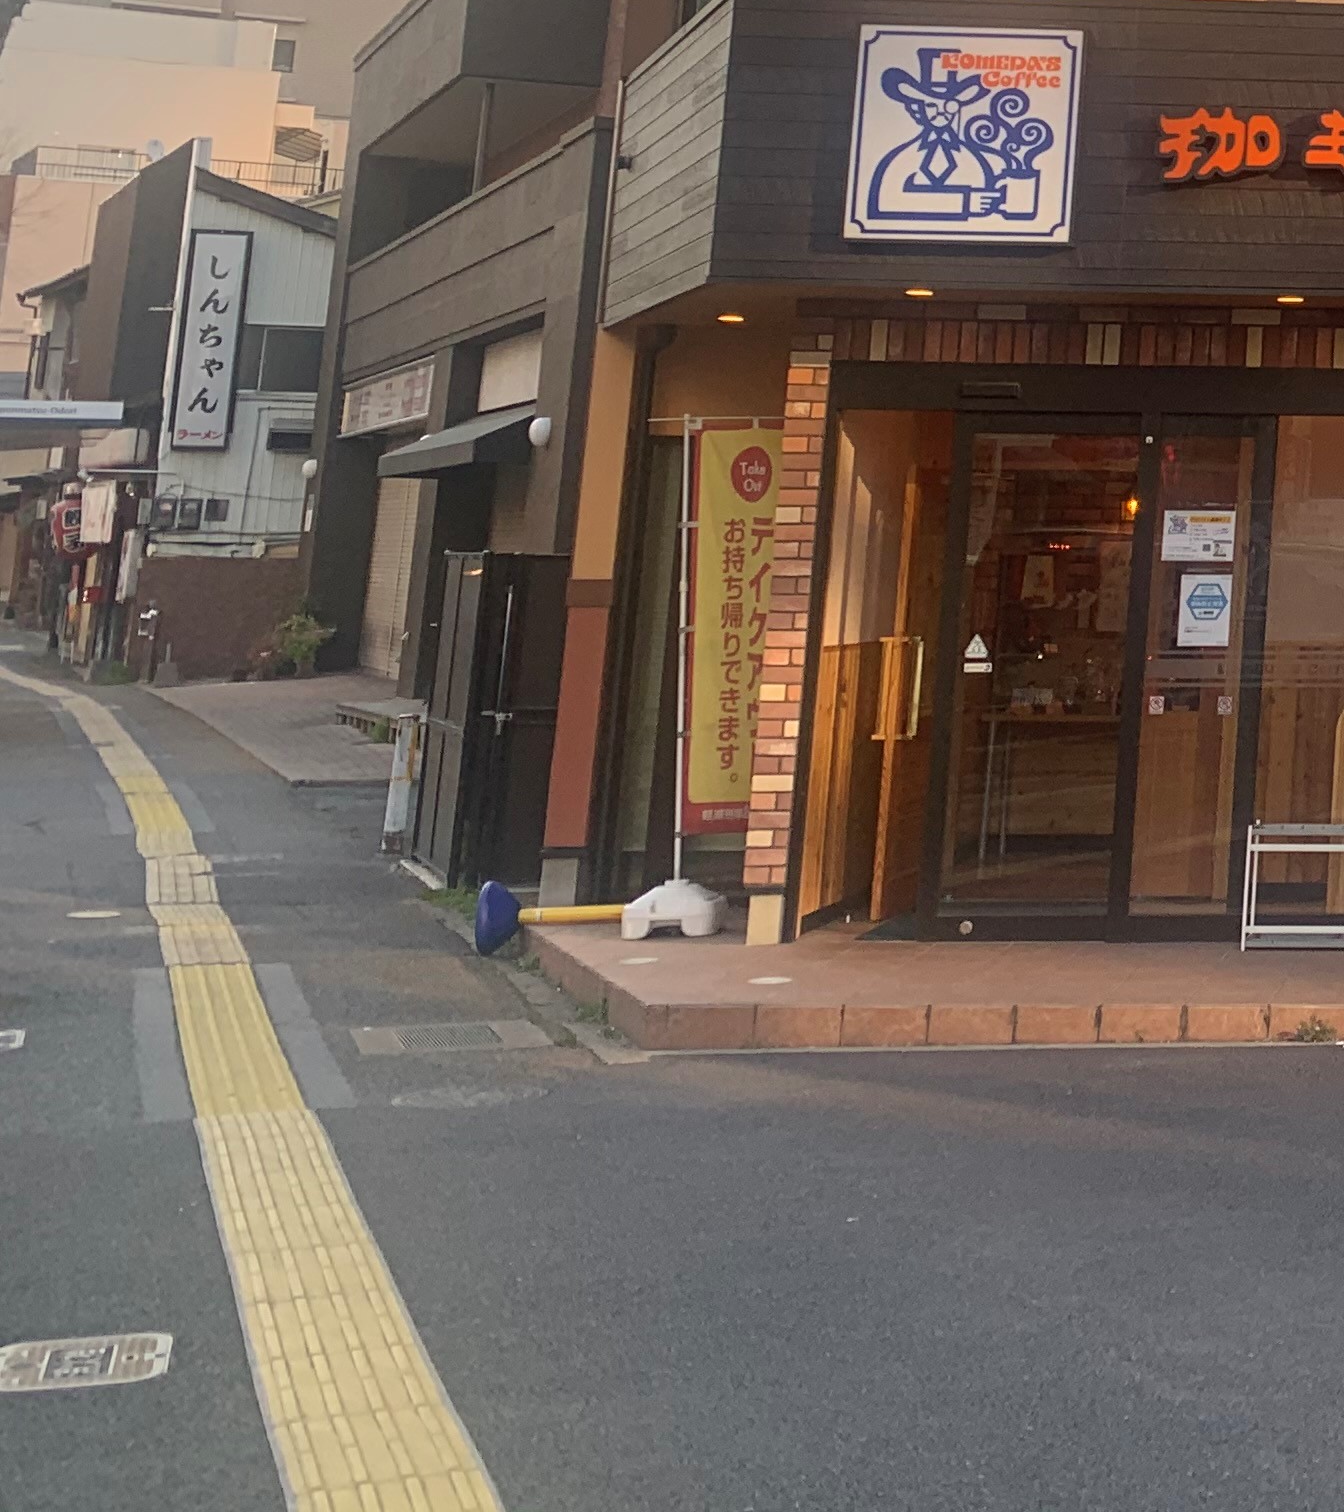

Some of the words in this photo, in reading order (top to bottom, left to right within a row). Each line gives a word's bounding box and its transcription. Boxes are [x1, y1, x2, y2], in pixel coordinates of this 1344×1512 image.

[941, 53, 1062, 71] KOMEDA'S
[982, 71, 1061, 88] Coffee
[188, 255, 230, 414] しんちゃん
[177, 429, 223, 442] ラーメン
[739, 461, 767, 477] Take
